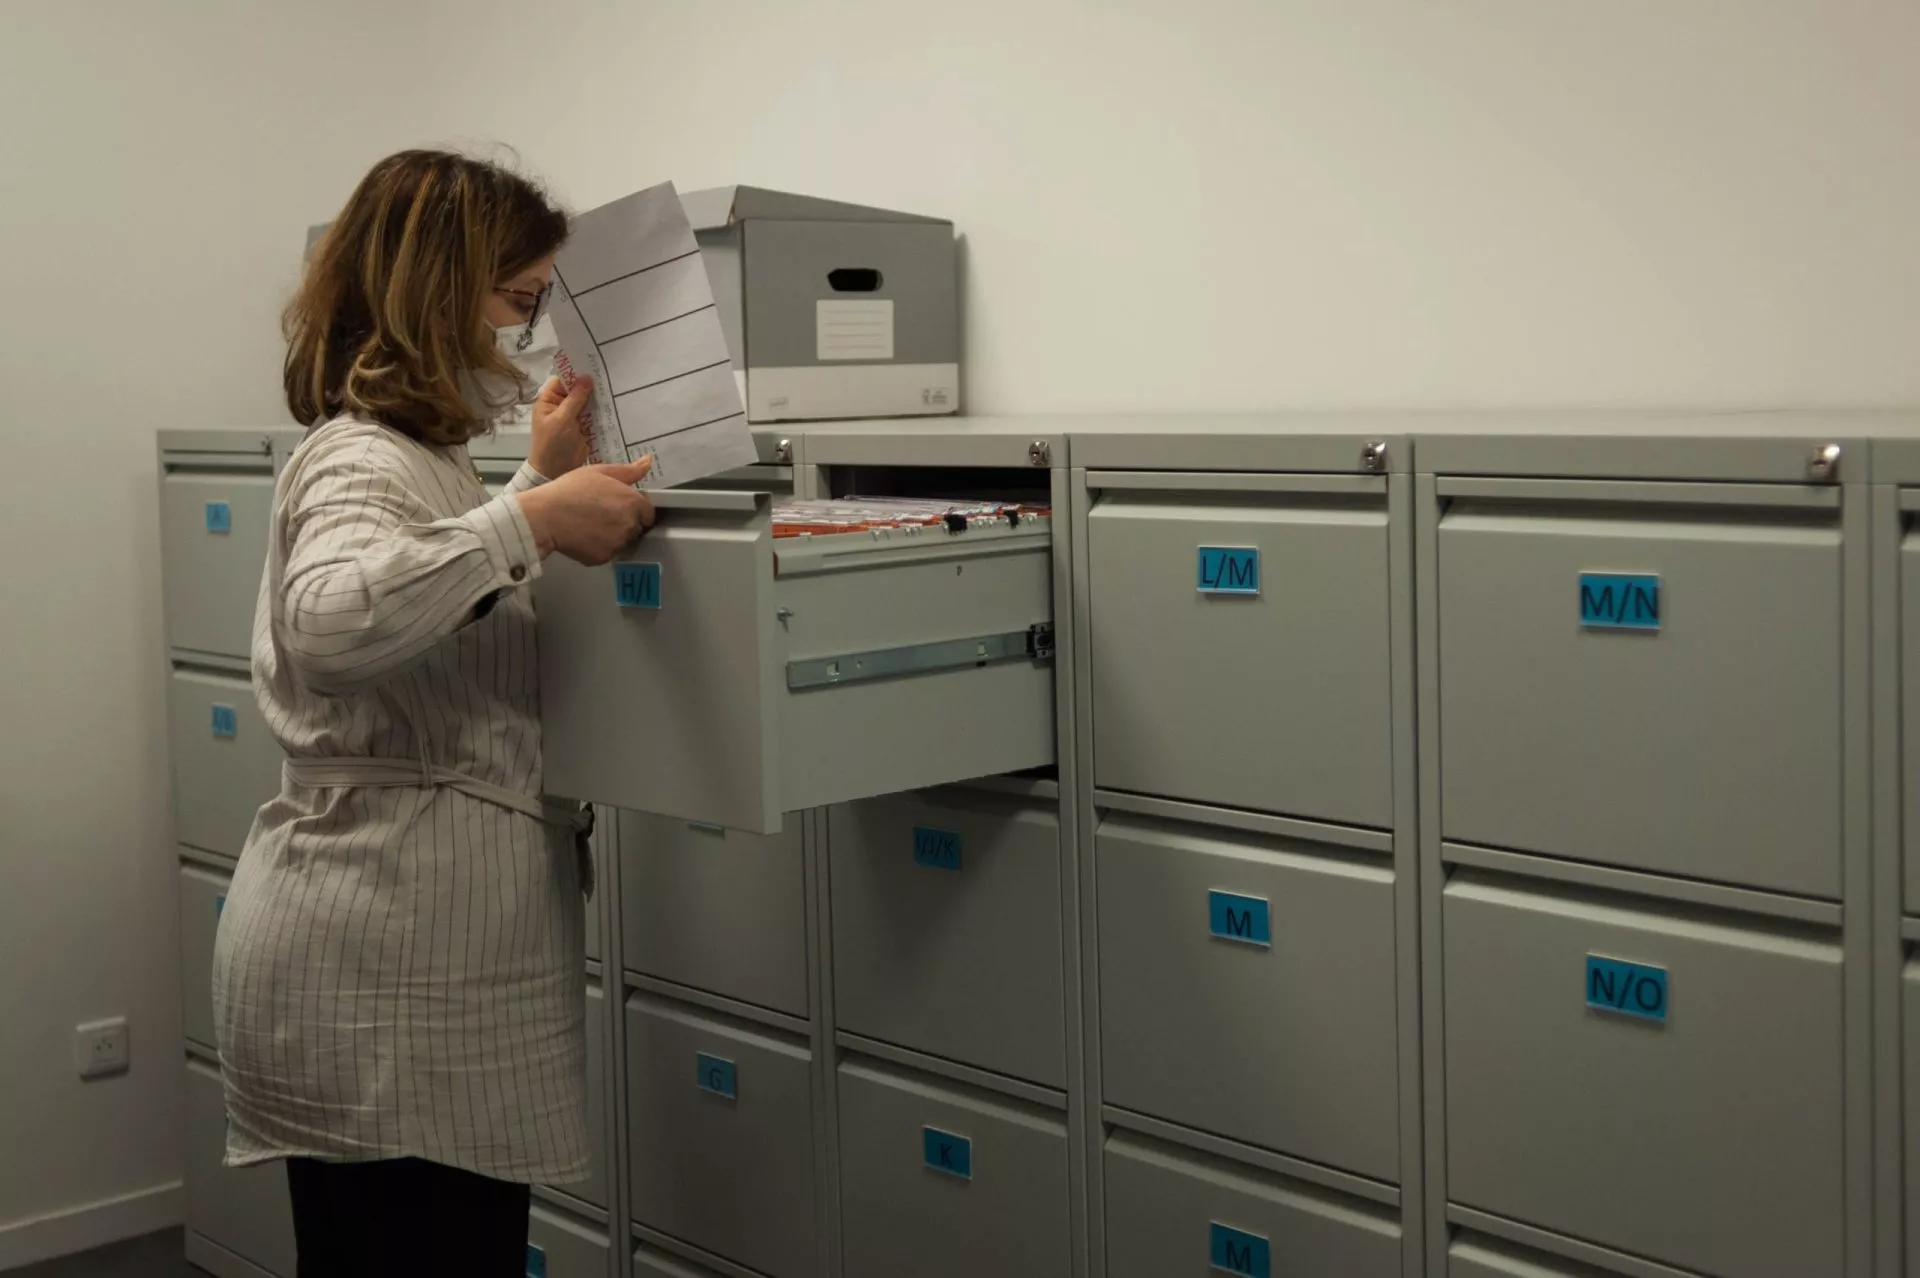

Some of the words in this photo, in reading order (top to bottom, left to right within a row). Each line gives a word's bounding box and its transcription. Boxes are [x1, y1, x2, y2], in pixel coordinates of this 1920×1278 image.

[621, 569, 651, 604] H/I
[1202, 552, 1253, 588] L/M
[1581, 582, 1658, 624] M/N
[916, 834, 954, 860] I/J/K
[1226, 906, 1251, 938] M
[1592, 967, 1662, 1010] N/O
[710, 1068, 722, 1090] G
[939, 1142, 953, 1169] K
[1226, 1240, 1251, 1274] M
